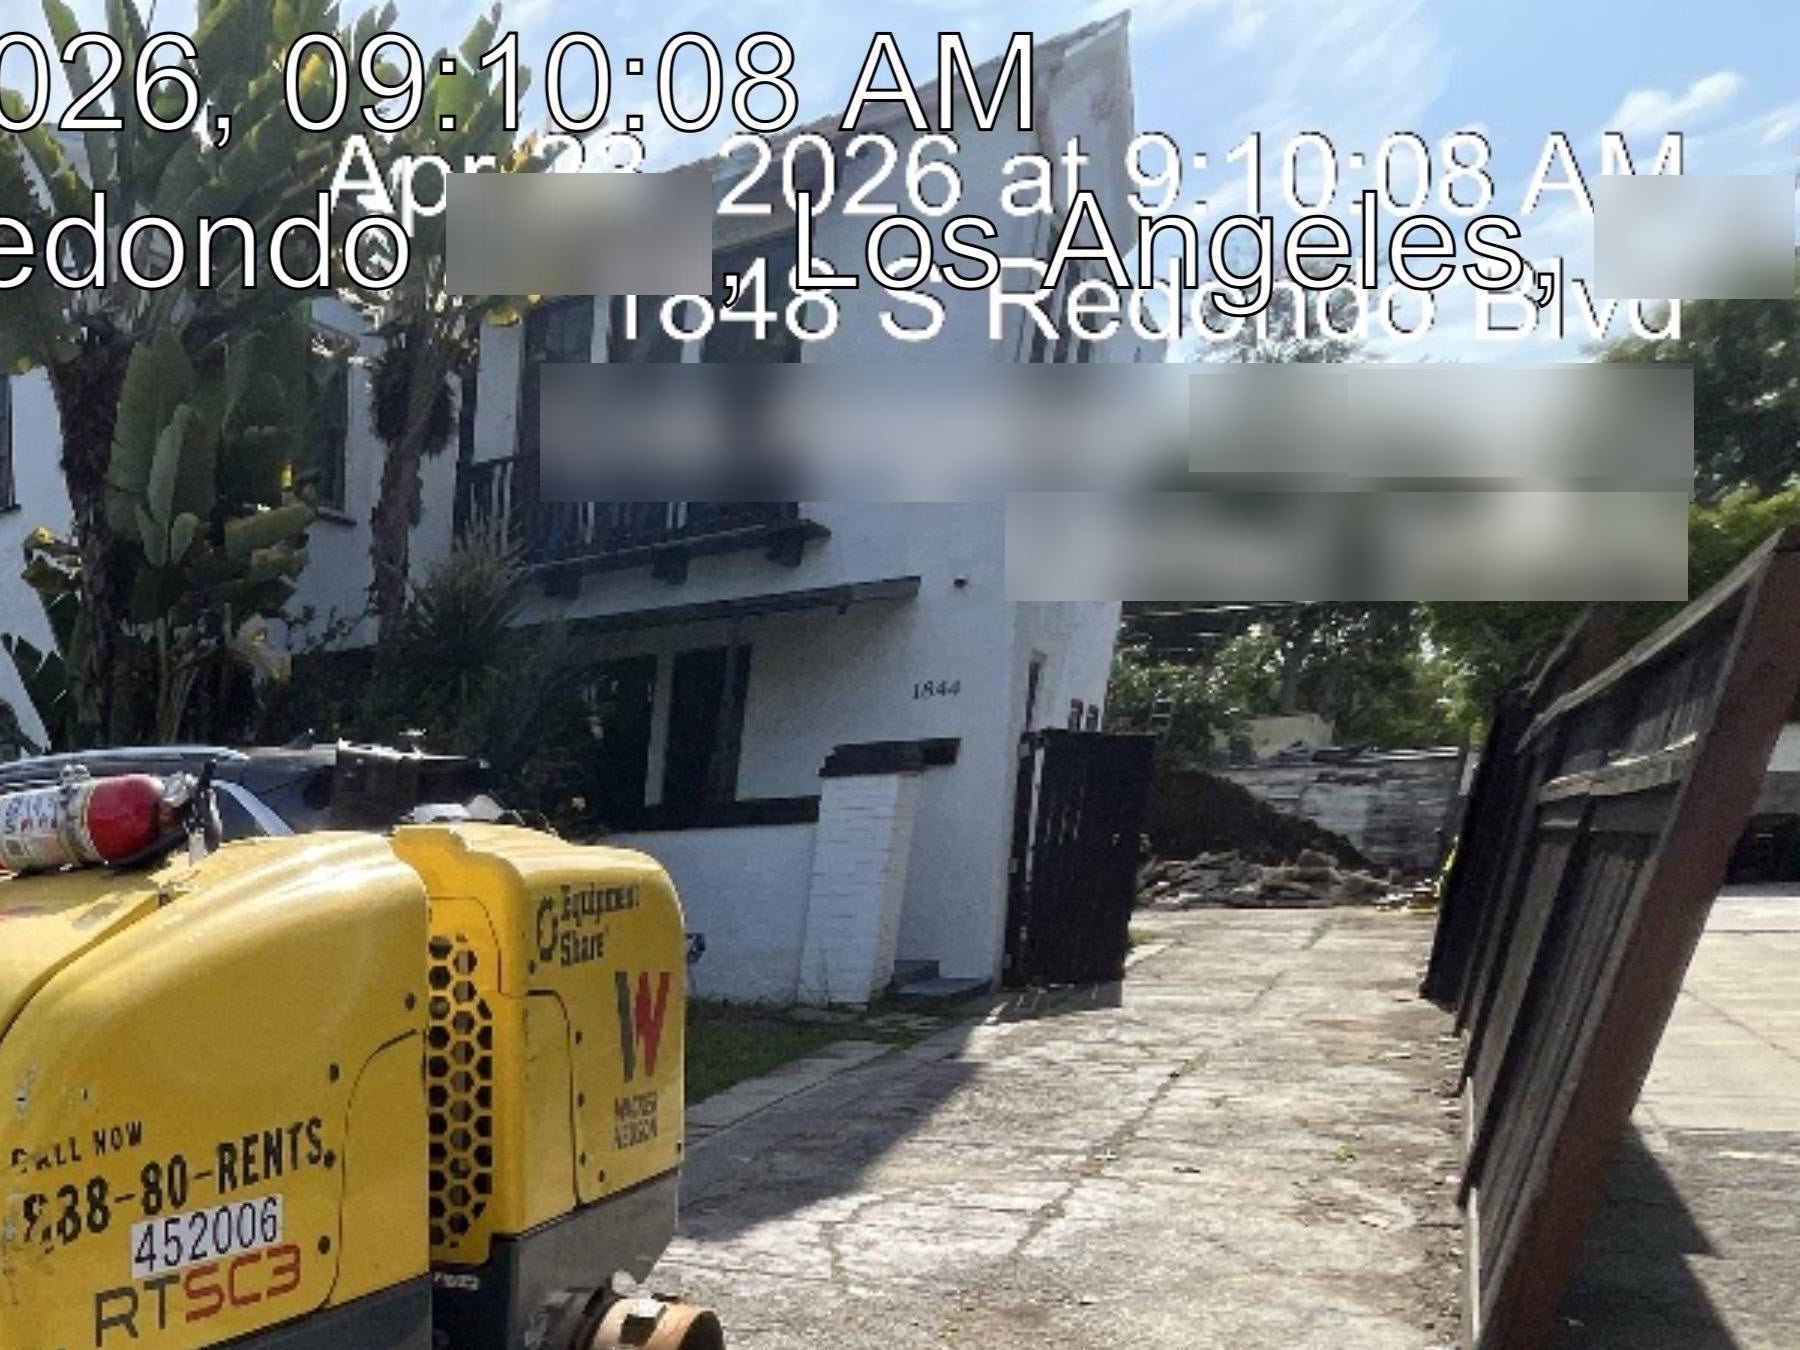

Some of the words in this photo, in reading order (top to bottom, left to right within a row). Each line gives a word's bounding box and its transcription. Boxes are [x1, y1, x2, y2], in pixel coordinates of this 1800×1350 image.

[913, 680, 961, 699] 1844
[92, 1121, 142, 1156] NOW
[134, 1198, 278, 1271] 452006
[94, 1244, 300, 1347] RTSC3
